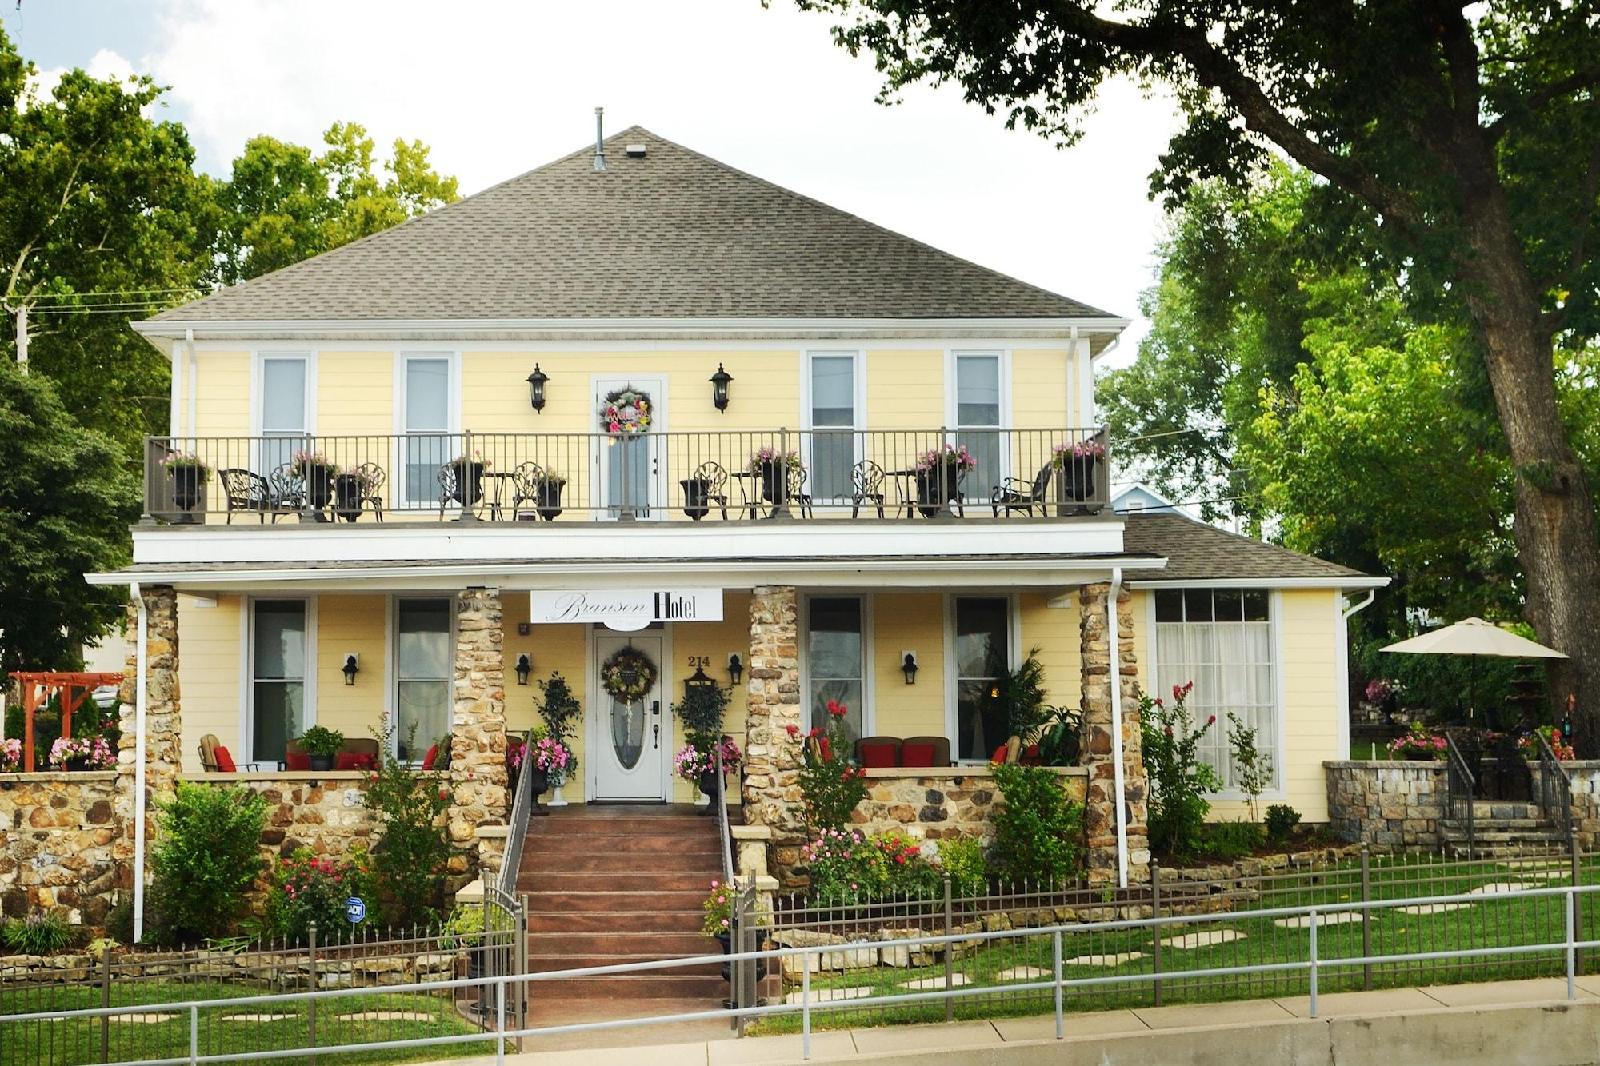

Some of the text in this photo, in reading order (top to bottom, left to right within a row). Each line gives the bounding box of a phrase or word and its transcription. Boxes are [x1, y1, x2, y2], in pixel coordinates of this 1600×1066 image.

[546, 592, 696, 621] Branson Hotel
[688, 656, 711, 668] 214
